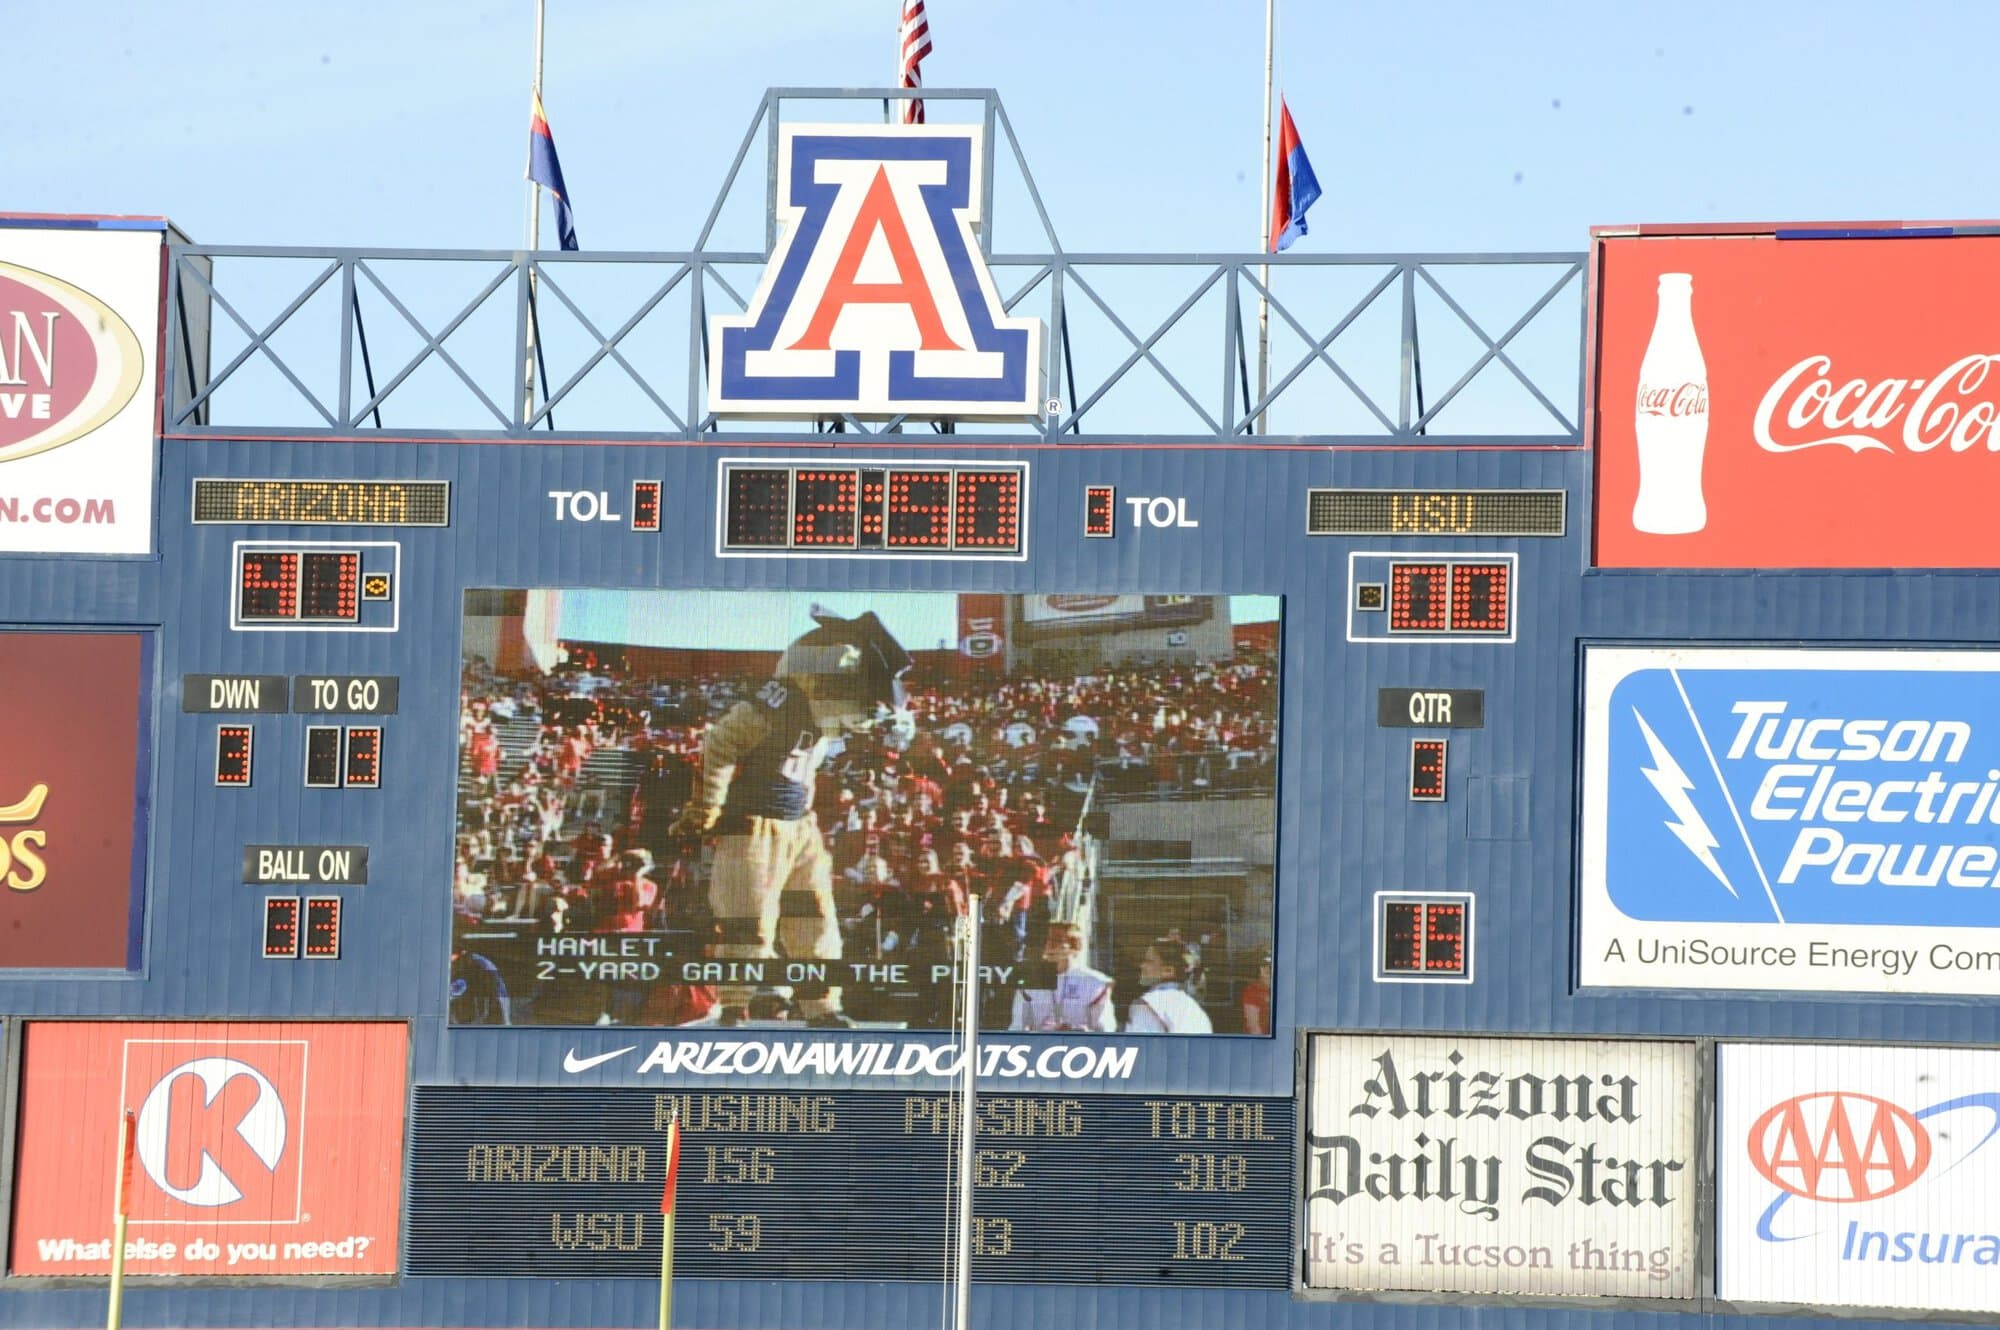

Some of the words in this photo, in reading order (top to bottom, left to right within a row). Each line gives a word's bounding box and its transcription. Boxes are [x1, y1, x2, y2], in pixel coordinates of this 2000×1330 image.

[709, 123, 1040, 415] A
[1639, 382, 1707, 417] Coca-Cola
[237, 482, 406, 522] ARIZONA
[549, 490, 621, 521] TOL
[634, 485, 660, 527] 3
[796, 472, 1018, 546] 2:50
[1086, 488, 1113, 534] 3
[1125, 497, 1198, 527] TOL
[1392, 495, 1473, 532] WSU
[244, 554, 357, 616] 41
[1392, 565, 1507, 628] 00
[210, 679, 260, 710] DWN
[311, 680, 339, 710] TO
[347, 680, 380, 710] GO
[1409, 691, 1452, 724] QTR
[218, 729, 250, 782] 3
[1726, 701, 1972, 763] Tucson
[348, 730, 379, 782] 3
[1413, 743, 1444, 795] 3
[0, 829, 47, 892] S
[259, 850, 310, 880] BALL
[318, 851, 350, 881] ON
[1777, 827, 2000, 888] Powe
[267, 900, 337, 954] 33
[537, 937, 673, 958] HAMLET.
[1413, 905, 1463, 968] 15
[536, 961, 660, 981] 2-YARD
[682, 963, 765, 982] GAIN
[786, 963, 826, 983] ON
[854, 964, 908, 984] THE
[1604, 938, 1626, 963] A
[1638, 938, 1797, 967] UniSource
[1808, 941, 1919, 975] Energy
[1349, 1048, 1642, 1125] Arizona
[654, 1095, 836, 1133] RUSHING
[1144, 1101, 1276, 1140] TOTAL
[467, 1144, 646, 1183] ARIZONA
[703, 1146, 776, 1184] 156
[1174, 1154, 1248, 1192] 318
[1768, 1095, 1920, 1201] AAA
[1306, 1128, 1502, 1222] Daily
[1522, 1136, 1686, 1208] Star
[37, 1237, 112, 1262] What
[123, 1237, 177, 1261] else
[184, 1237, 220, 1260] do
[227, 1243, 276, 1265] you
[283, 1235, 369, 1260] need?
[551, 1213, 644, 1251] WSU
[708, 1214, 761, 1252] 59
[1172, 1221, 1246, 1260] 102
[1309, 1232, 1364, 1265] It's
[1378, 1242, 1401, 1266] a
[1415, 1233, 1554, 1270] Tucson
[1568, 1238, 1682, 1281] thing.
[1842, 1220, 2000, 1266] Insura
